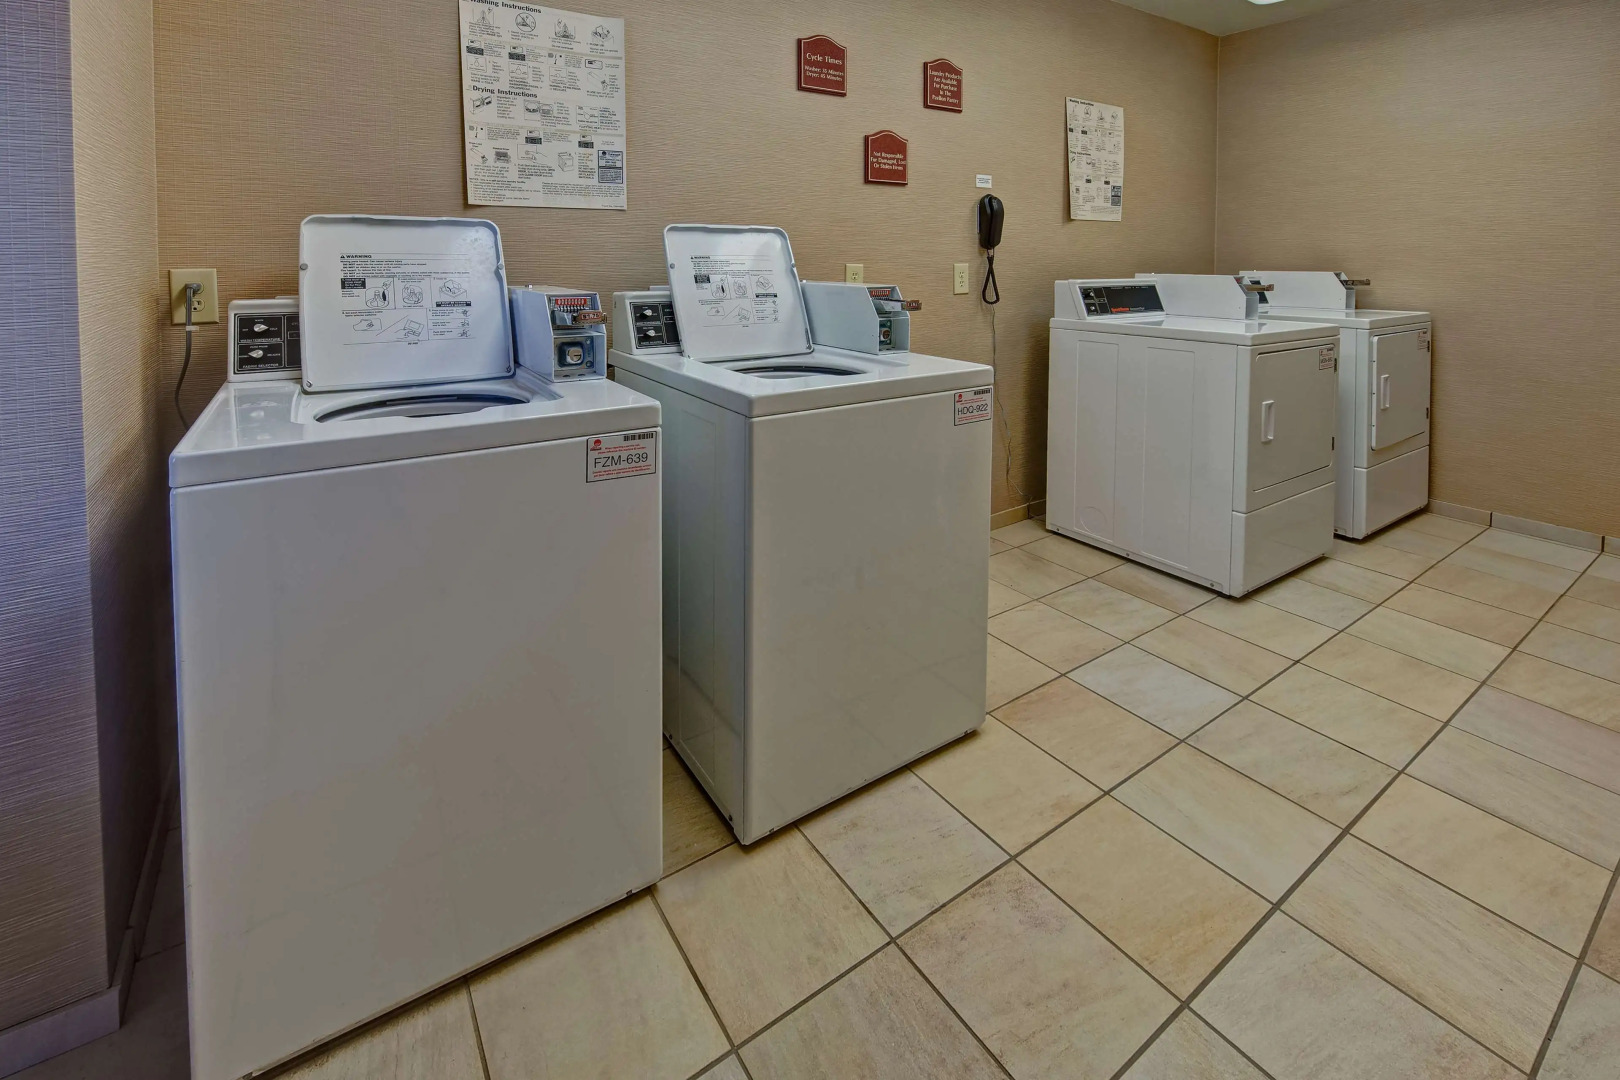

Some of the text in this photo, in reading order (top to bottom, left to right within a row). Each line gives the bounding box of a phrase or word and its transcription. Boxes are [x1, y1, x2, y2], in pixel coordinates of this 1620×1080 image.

[502, 2, 542, 14] Instructions
[806, 52, 842, 66] Cycle Times
[472, 85, 538, 99] Drying Instructions
[958, 403, 988, 415] HDQ-922
[594, 452, 648, 468] FZM-639
